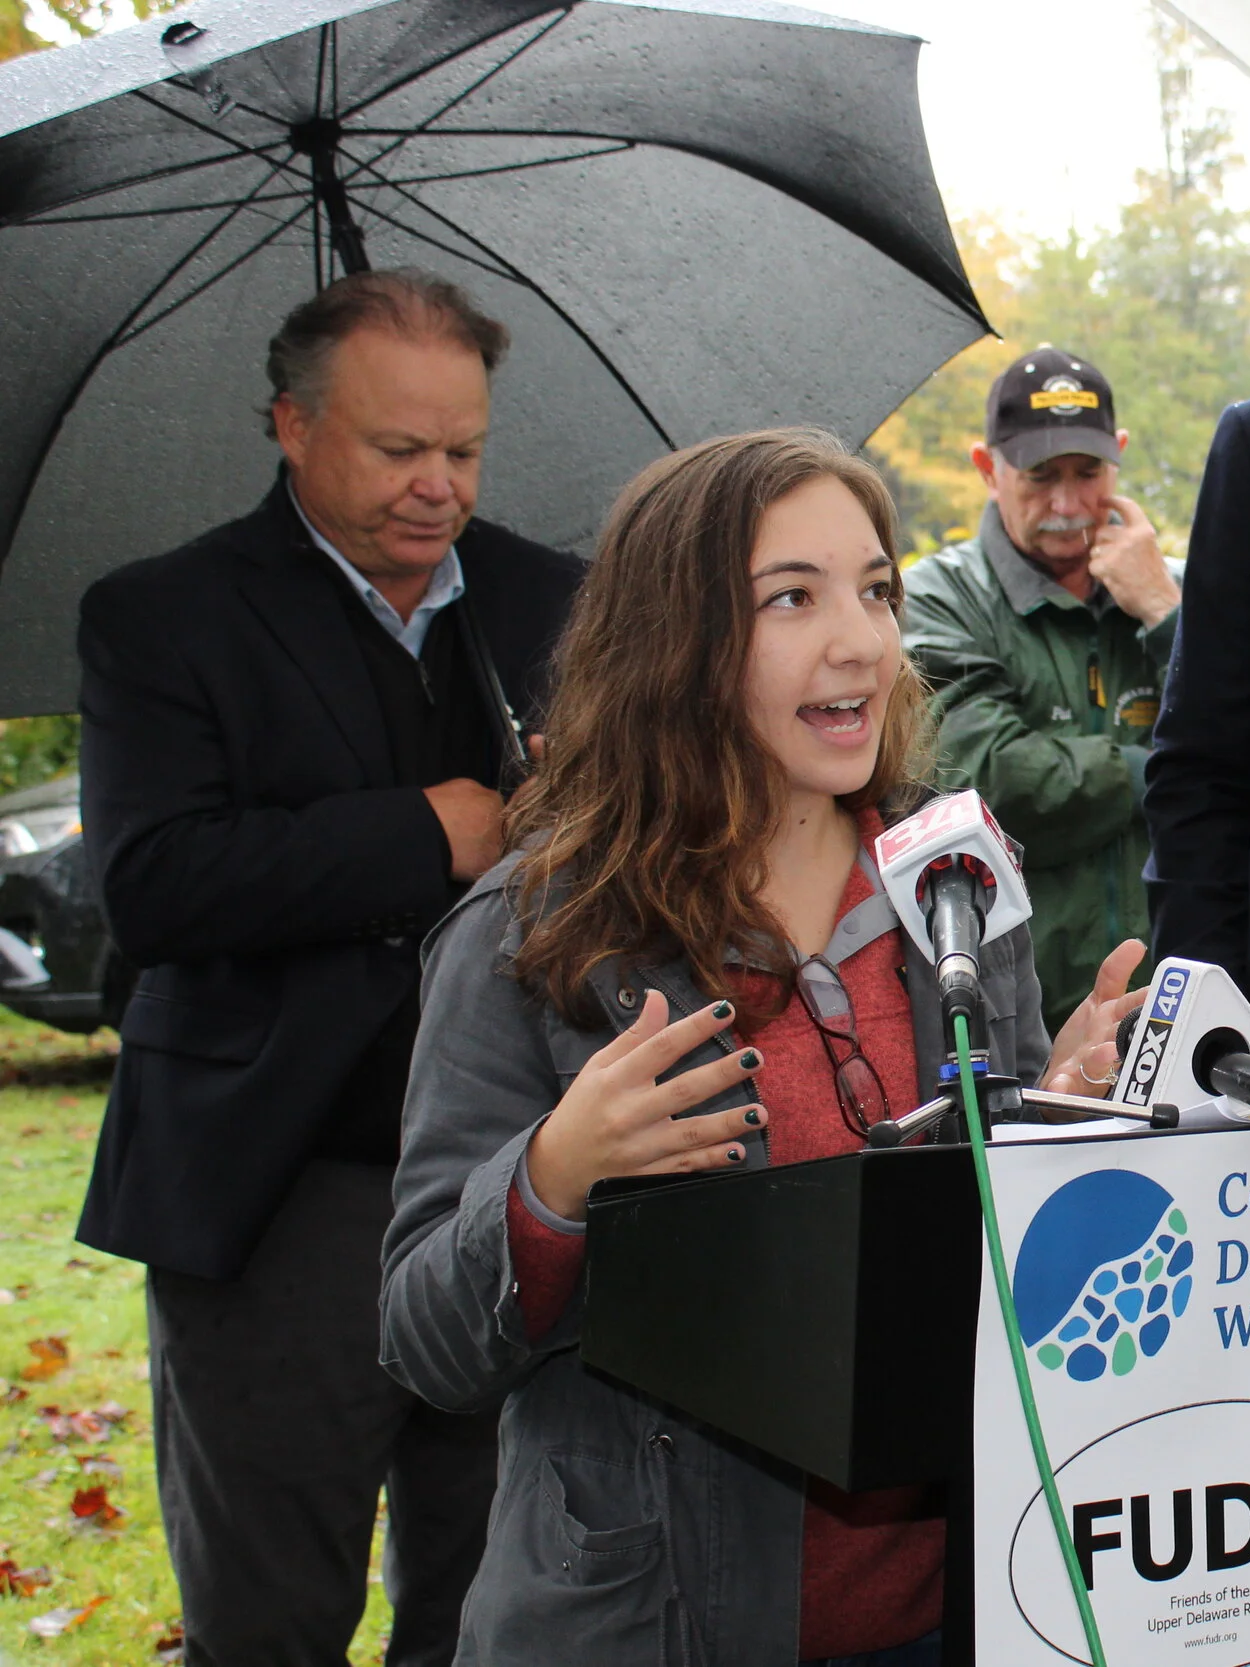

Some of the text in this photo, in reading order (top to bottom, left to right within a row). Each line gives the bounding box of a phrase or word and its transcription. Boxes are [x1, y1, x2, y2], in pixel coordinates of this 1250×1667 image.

[886, 803, 964, 862] 34
[1125, 971, 1186, 1106] FOX 40
[1170, 1585, 1250, 1610] Friends of the
[1147, 1616, 1182, 1634] Upper
[1186, 1606, 1240, 1626] Delaware
[1184, 1631, 1238, 1649] www.fudr.org
